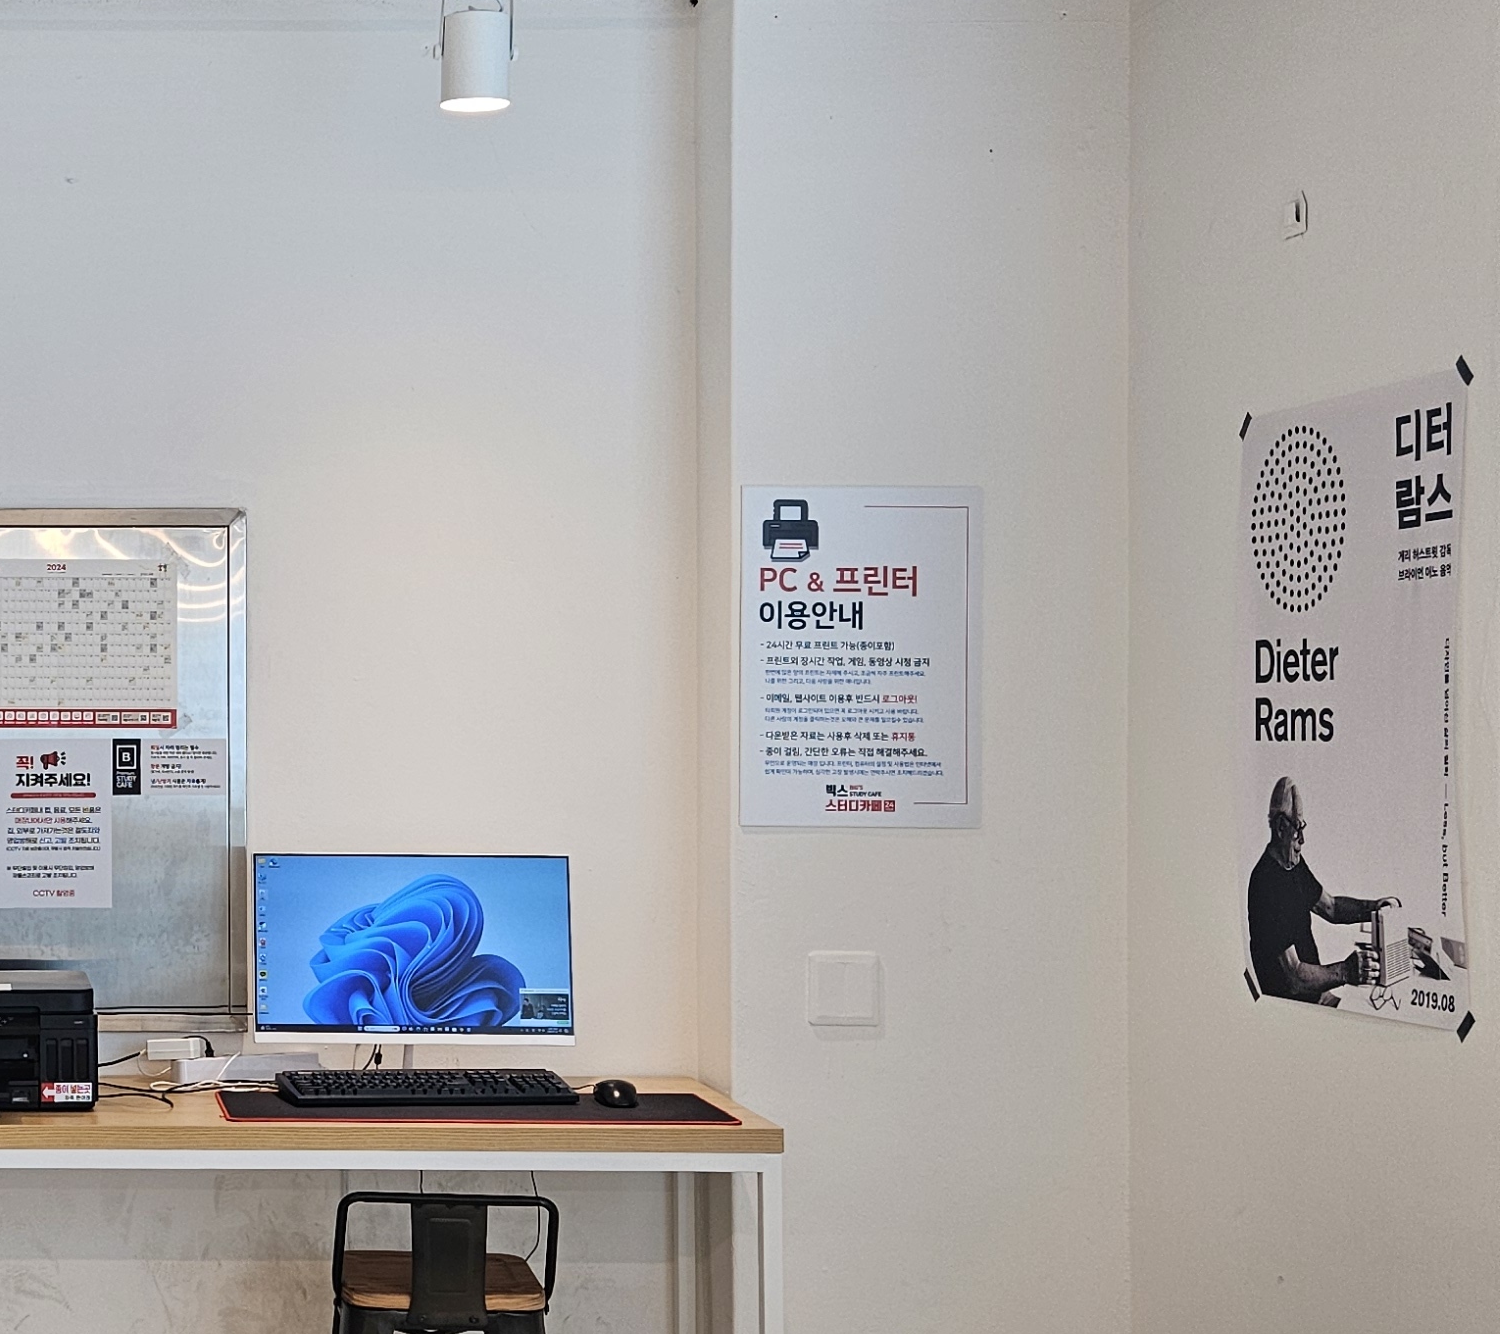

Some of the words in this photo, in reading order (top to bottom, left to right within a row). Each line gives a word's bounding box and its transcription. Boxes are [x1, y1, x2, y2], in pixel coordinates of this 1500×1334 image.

[1395, 402, 1453, 461] 디터
[1395, 474, 1453, 530] 람스
[760, 568, 798, 592] PC
[807, 572, 825, 592] &
[833, 566, 918, 597] 프린터
[1398, 566, 1424, 581] 브라이언
[759, 600, 863, 630] 이용안내
[1255, 638, 1339, 684] Dieter
[1255, 696, 1334, 742] Rams
[16, 756, 34, 770] 꼭!
[122, 752, 131, 762] B
[15, 773, 91, 787] 지켜주세요!
[825, 784, 848, 797] 빅스
[1441, 844, 1449, 867] but
[33, 889, 55, 897] CCTV
[1410, 988, 1456, 1013] 2019.08
